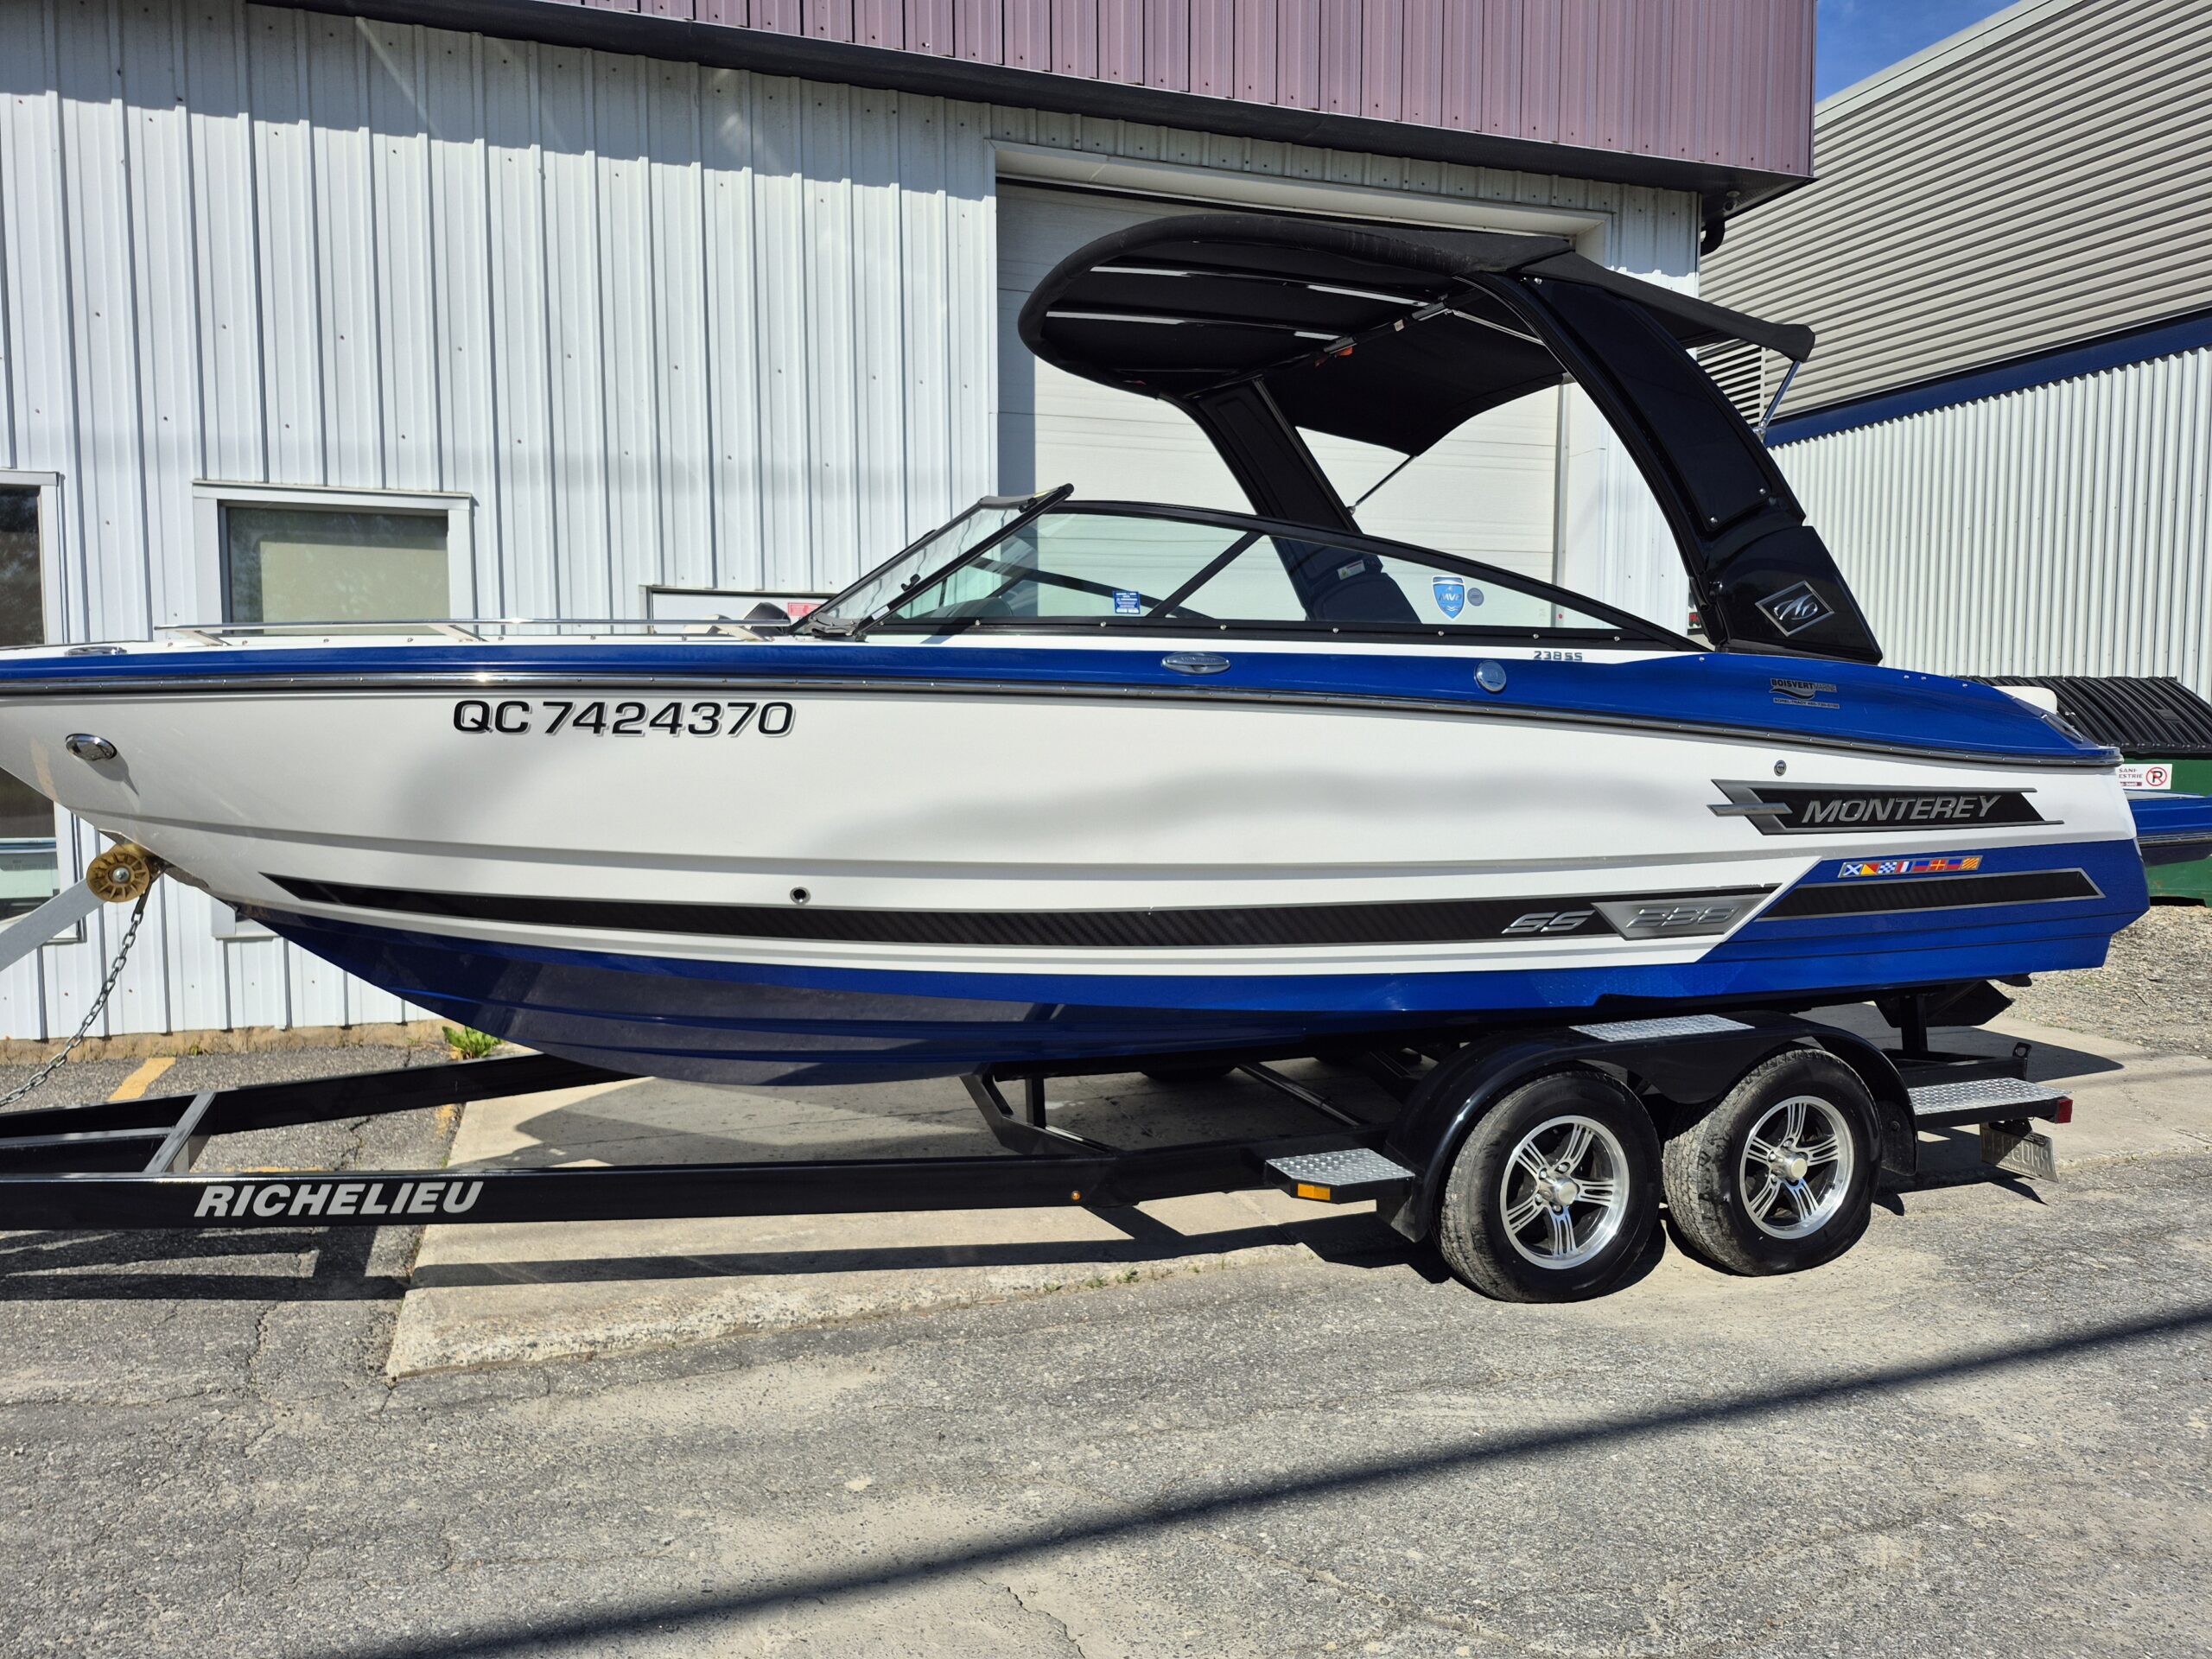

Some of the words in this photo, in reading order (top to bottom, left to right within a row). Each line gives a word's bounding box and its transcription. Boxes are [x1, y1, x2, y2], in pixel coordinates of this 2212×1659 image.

[1771, 678, 1814, 690] BOISVERT
[454, 700, 531, 734] QC
[542, 701, 796, 737] 7424370
[1802, 795, 2001, 823] MONTEREY
[194, 1181, 484, 1217] RICHELIEU
